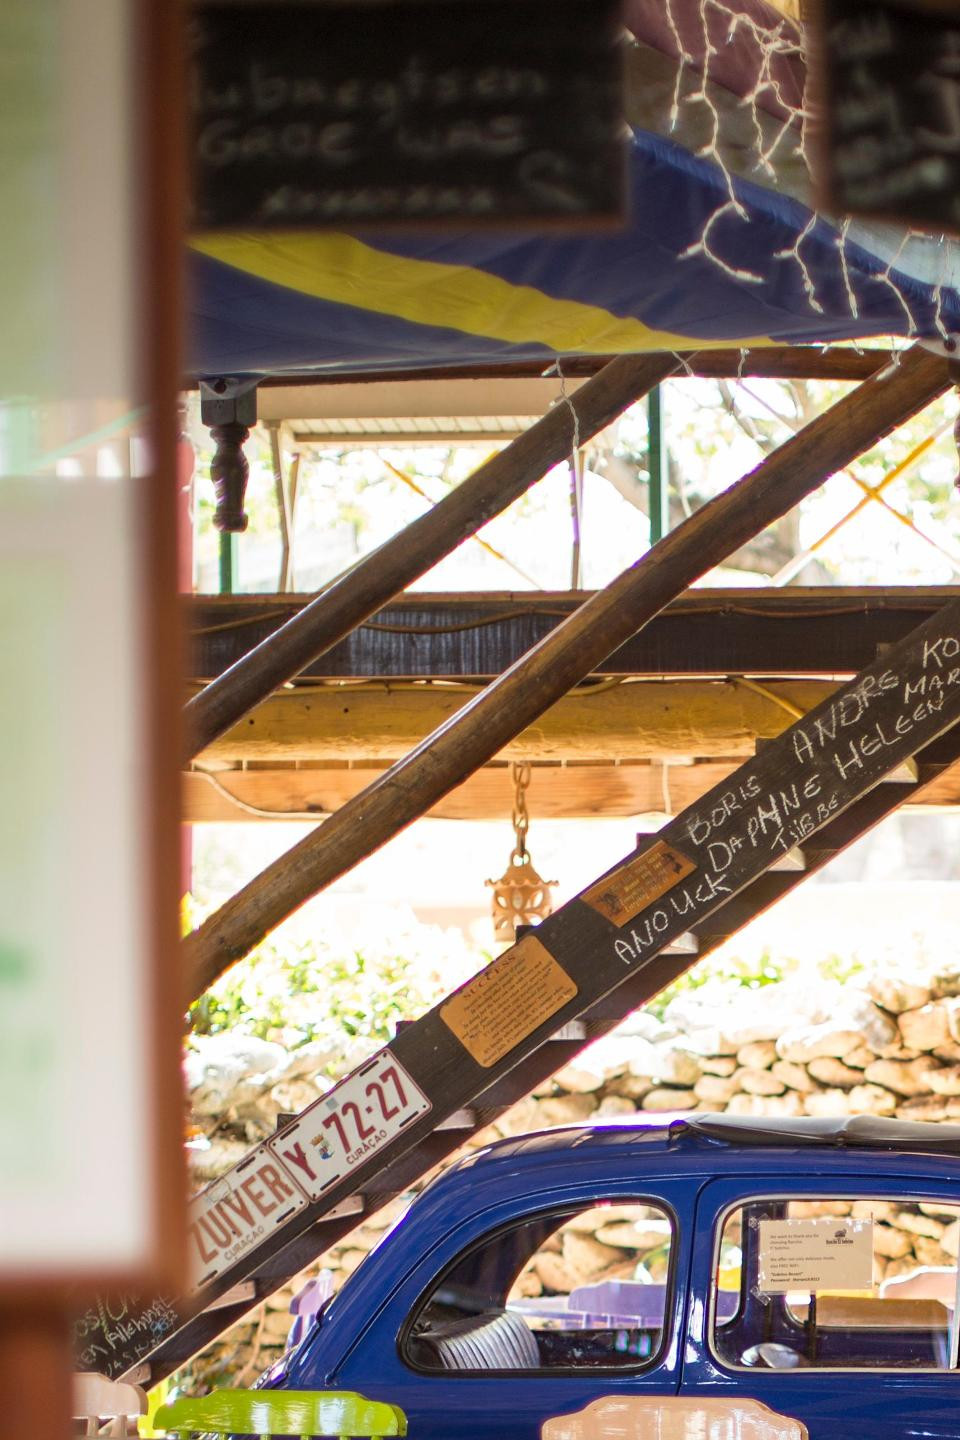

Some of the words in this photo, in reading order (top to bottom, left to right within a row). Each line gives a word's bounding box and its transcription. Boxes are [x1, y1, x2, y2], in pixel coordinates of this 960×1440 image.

[687, 775, 762, 846] BORIS
[793, 669, 900, 764] ANDRE
[834, 690, 945, 780] HELEEN
[282, 1142, 318, 1182] Y
[345, 1129, 388, 1165] CURAÇAO
[188, 1163, 295, 1265] ZUIVER
